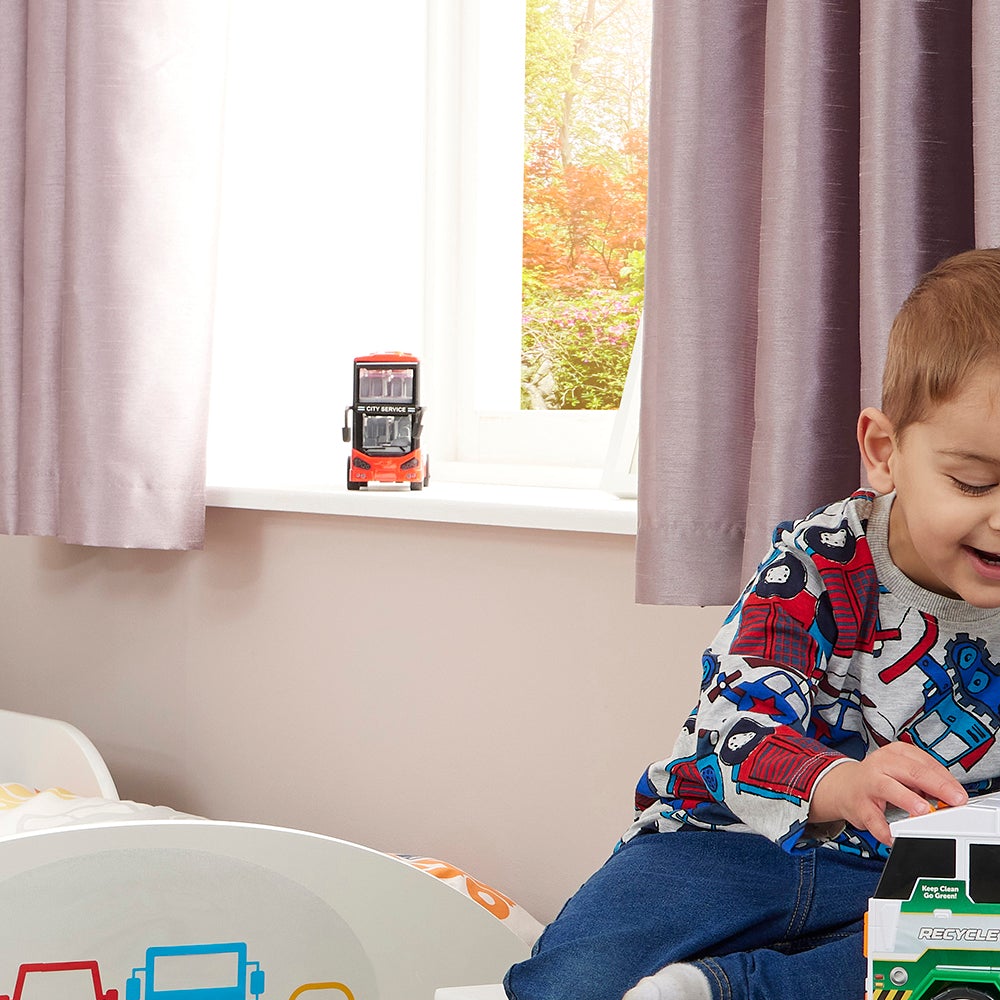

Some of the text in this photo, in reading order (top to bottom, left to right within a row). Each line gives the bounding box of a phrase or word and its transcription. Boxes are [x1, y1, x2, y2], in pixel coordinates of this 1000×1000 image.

[921, 885, 959, 893] Keep Clean
[934, 892, 957, 900] Green!
[918, 926, 1000, 942] RECYCLE
